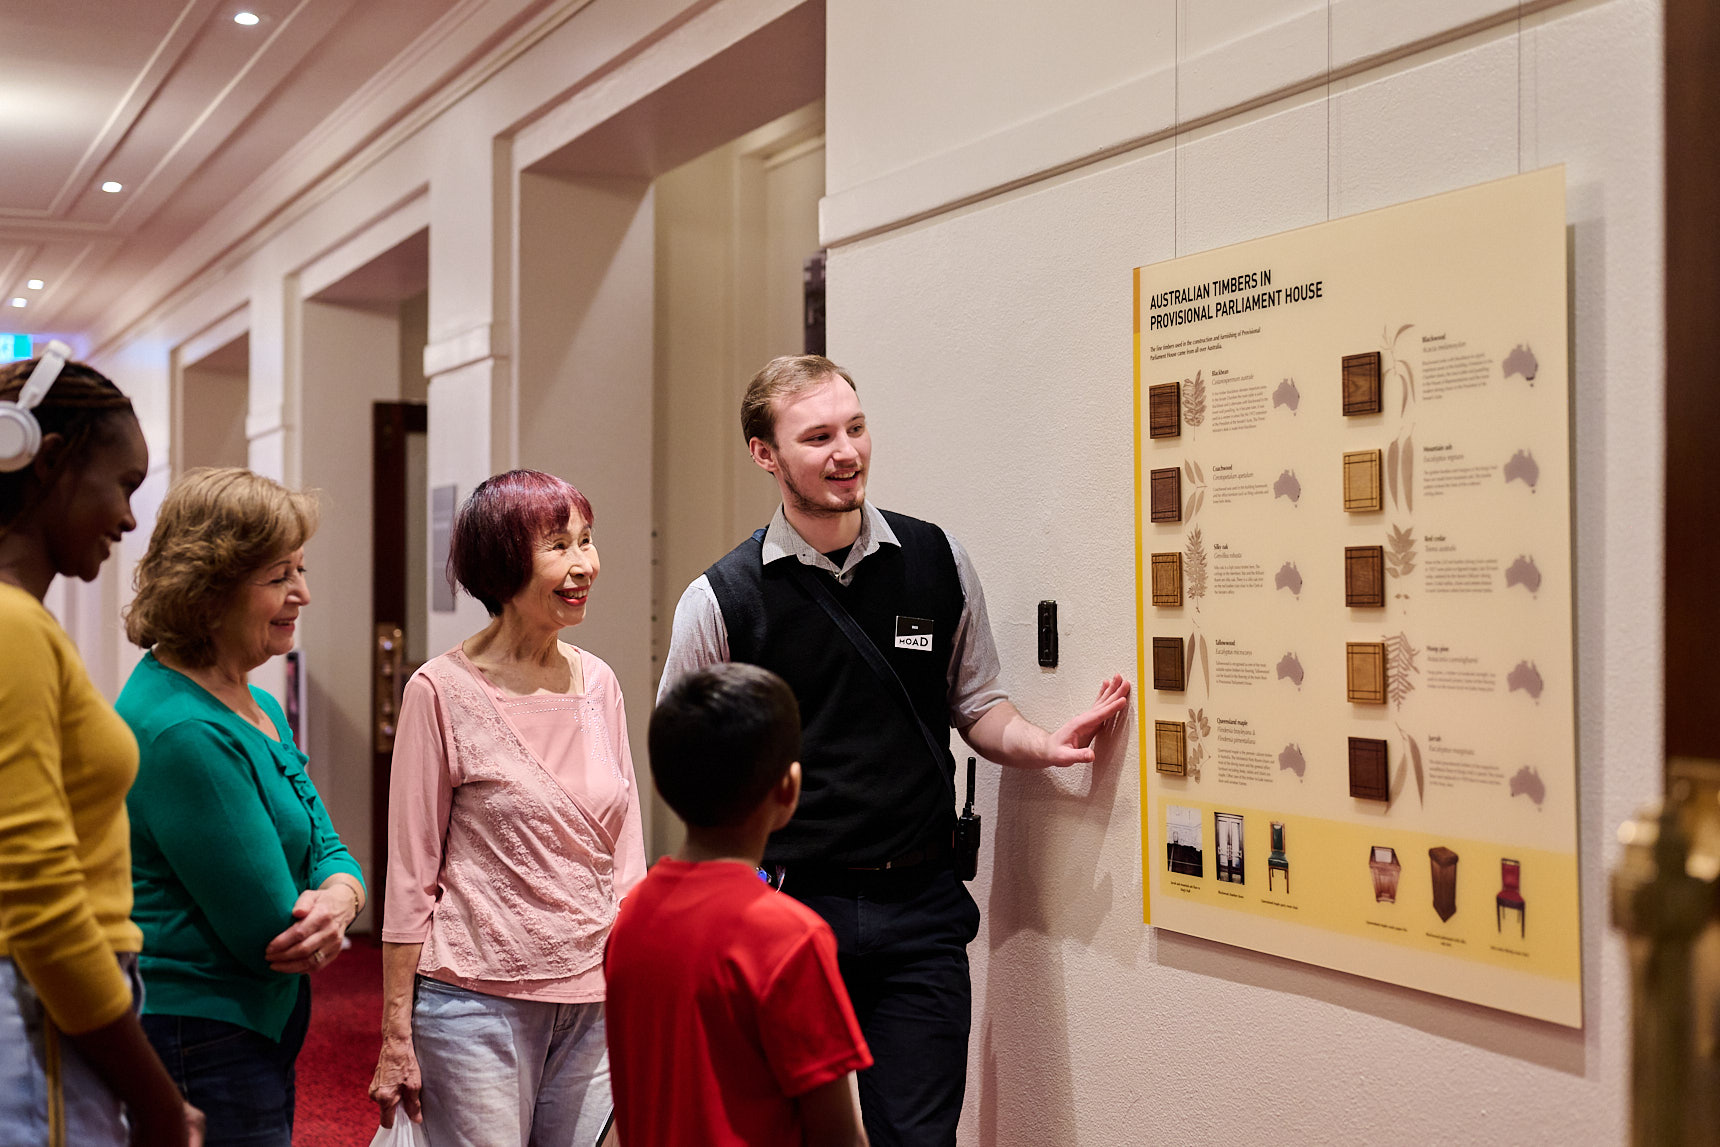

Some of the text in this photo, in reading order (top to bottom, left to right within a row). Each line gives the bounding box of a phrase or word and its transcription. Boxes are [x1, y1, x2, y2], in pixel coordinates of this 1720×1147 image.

[1150, 269, 1271, 310] AUSTRALIAN TIMBERS IN
[1150, 281, 1323, 331] PROVISIONAL PARLIAMENT HOUSE
[1163, 343, 1175, 352] timbers
[1175, 341, 1183, 349] used
[1192, 336, 1213, 345] construction
[1220, 331, 1237, 340] furnishing
[1242, 326, 1261, 336] Provisional
[1150, 352, 1167, 361] Parliament
[1177, 349, 1186, 357] came
[899, 636, 929, 647] MOAD
